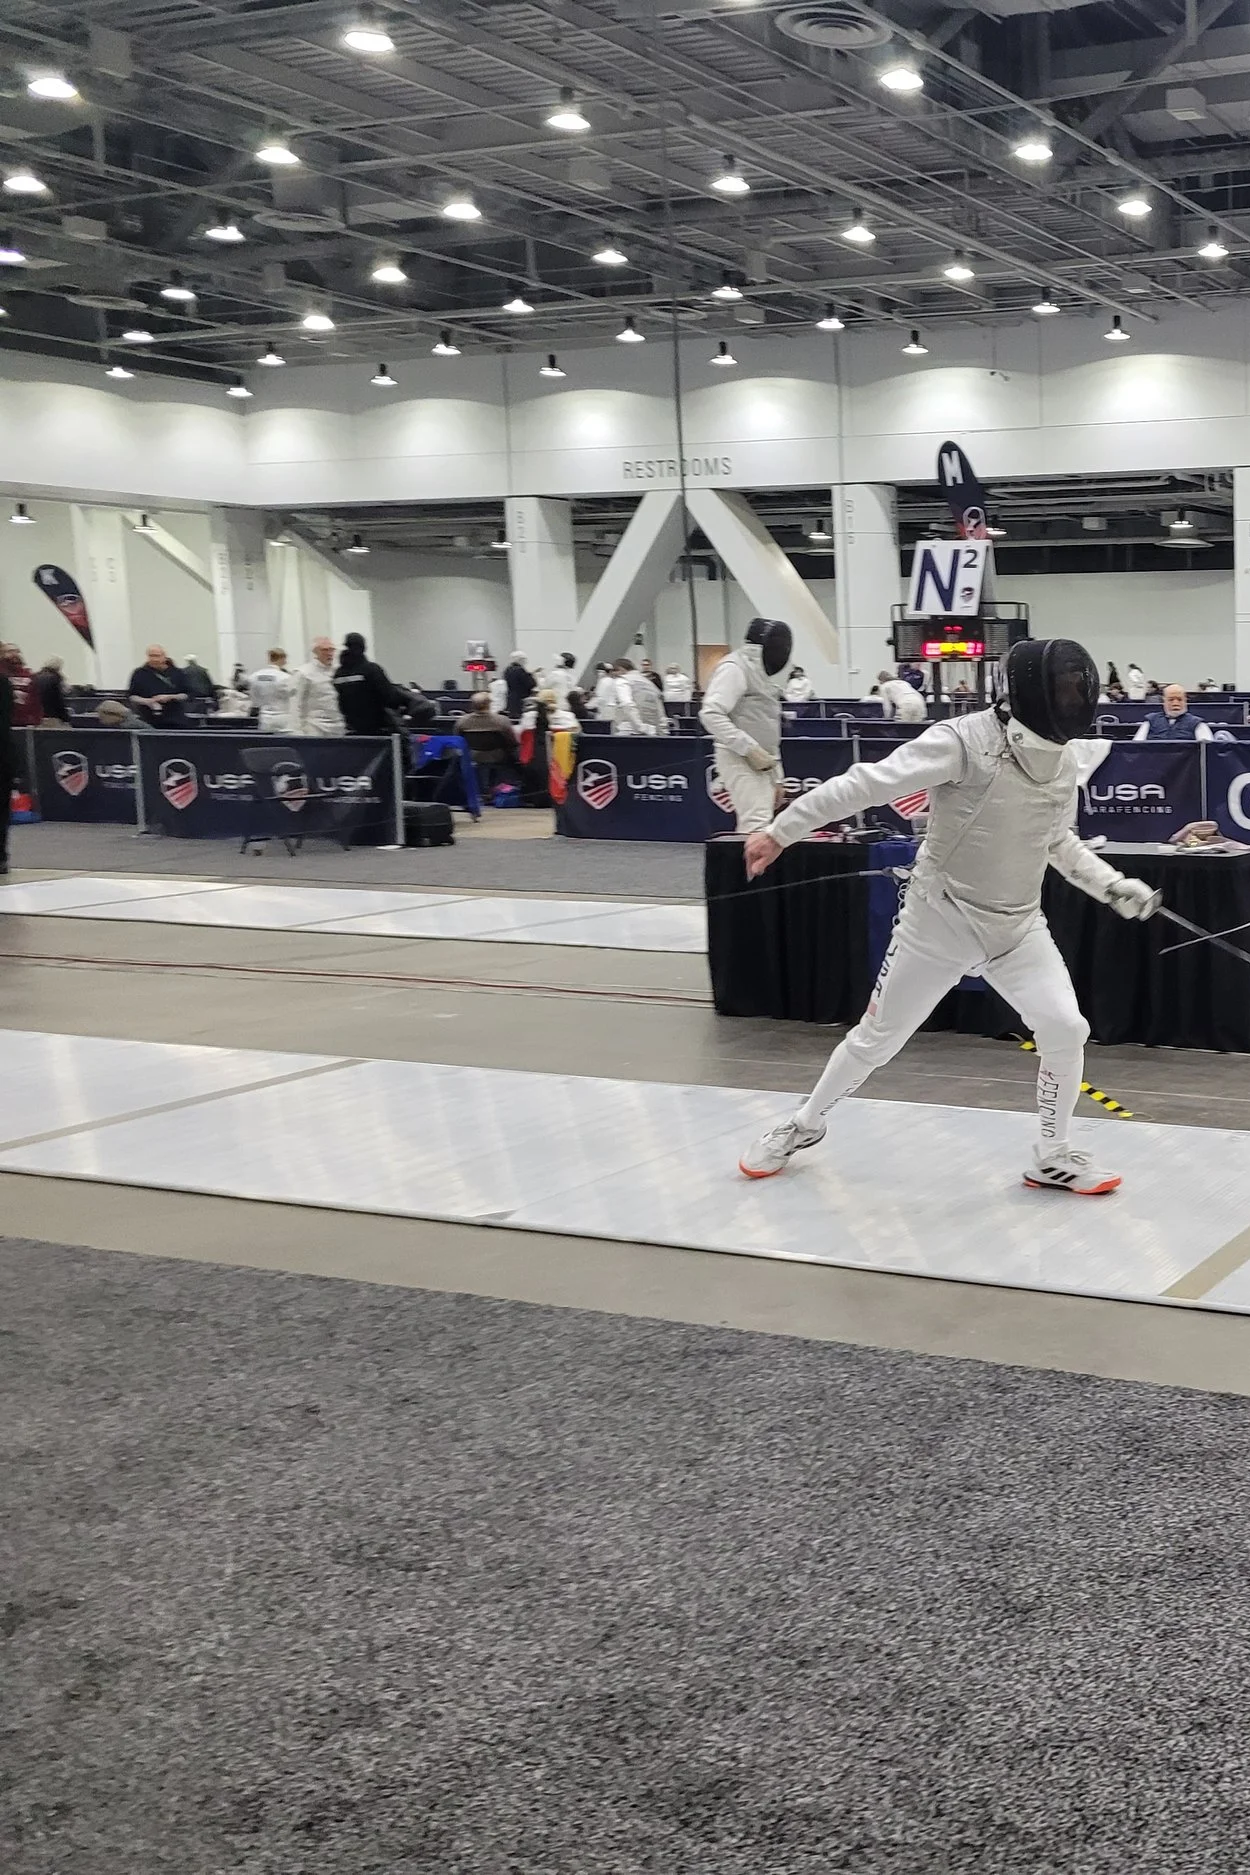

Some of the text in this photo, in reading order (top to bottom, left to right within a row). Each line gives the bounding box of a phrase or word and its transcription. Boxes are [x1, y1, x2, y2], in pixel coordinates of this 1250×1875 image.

[623, 457, 732, 479] RESTROOMS
[941, 450, 964, 487] M
[315, 775, 373, 791] USA
[626, 774, 688, 790] USA
[1090, 783, 1165, 801] USA
